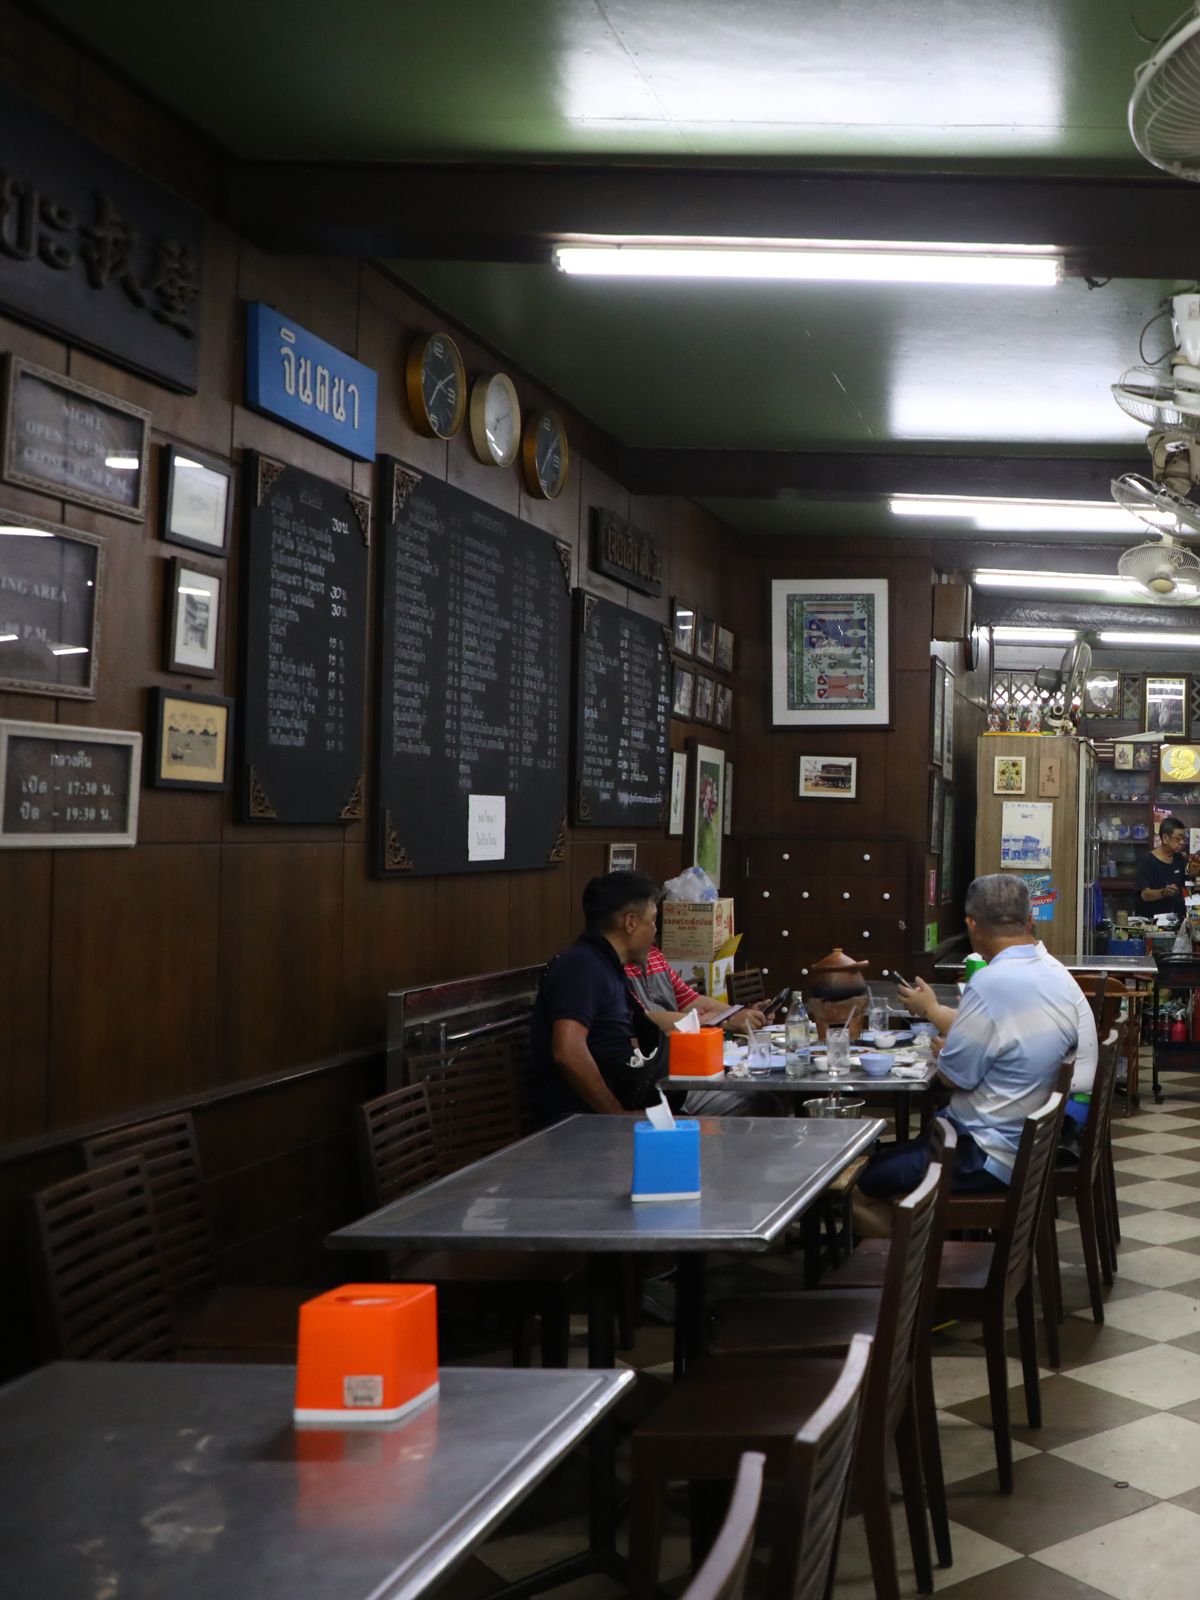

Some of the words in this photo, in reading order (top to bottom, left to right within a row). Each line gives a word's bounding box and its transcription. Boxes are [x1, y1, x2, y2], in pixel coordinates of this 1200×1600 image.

[279, 327, 359, 430] จินตนา
[31, 584, 68, 603] AREA
[67, 781, 97, 796] 17:30
[65, 807, 96, 821] 19:30
